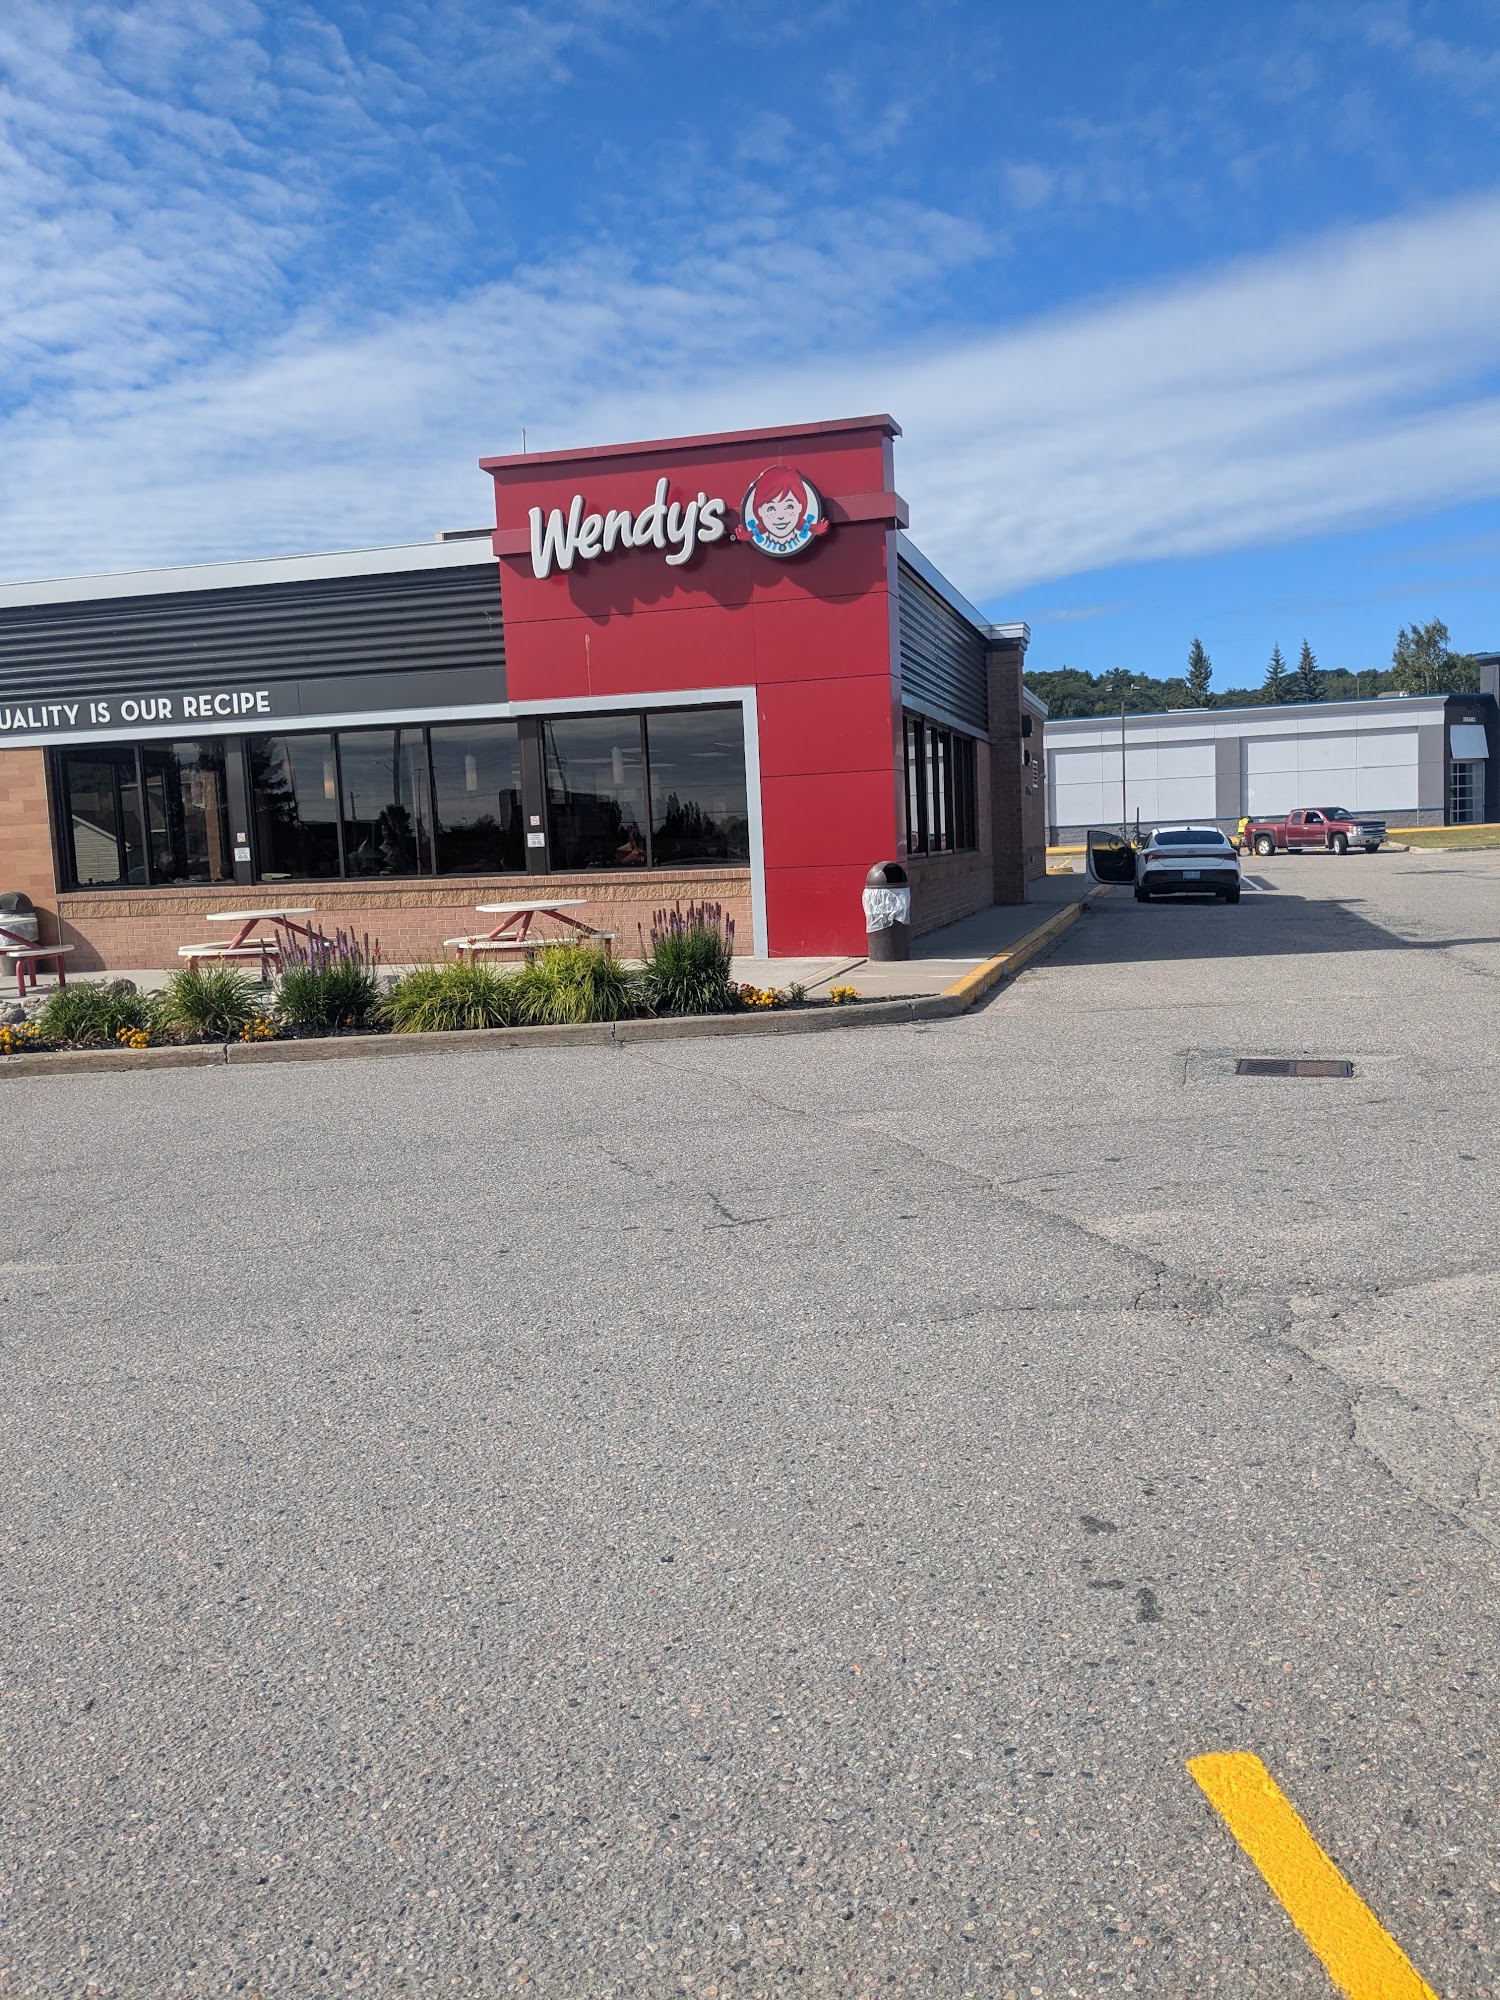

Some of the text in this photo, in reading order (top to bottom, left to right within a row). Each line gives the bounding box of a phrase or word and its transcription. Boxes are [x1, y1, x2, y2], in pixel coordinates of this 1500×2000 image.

[529, 477, 726, 579] Wendy's
[0, 691, 271, 730] UALITY IS OUR RECIPE
